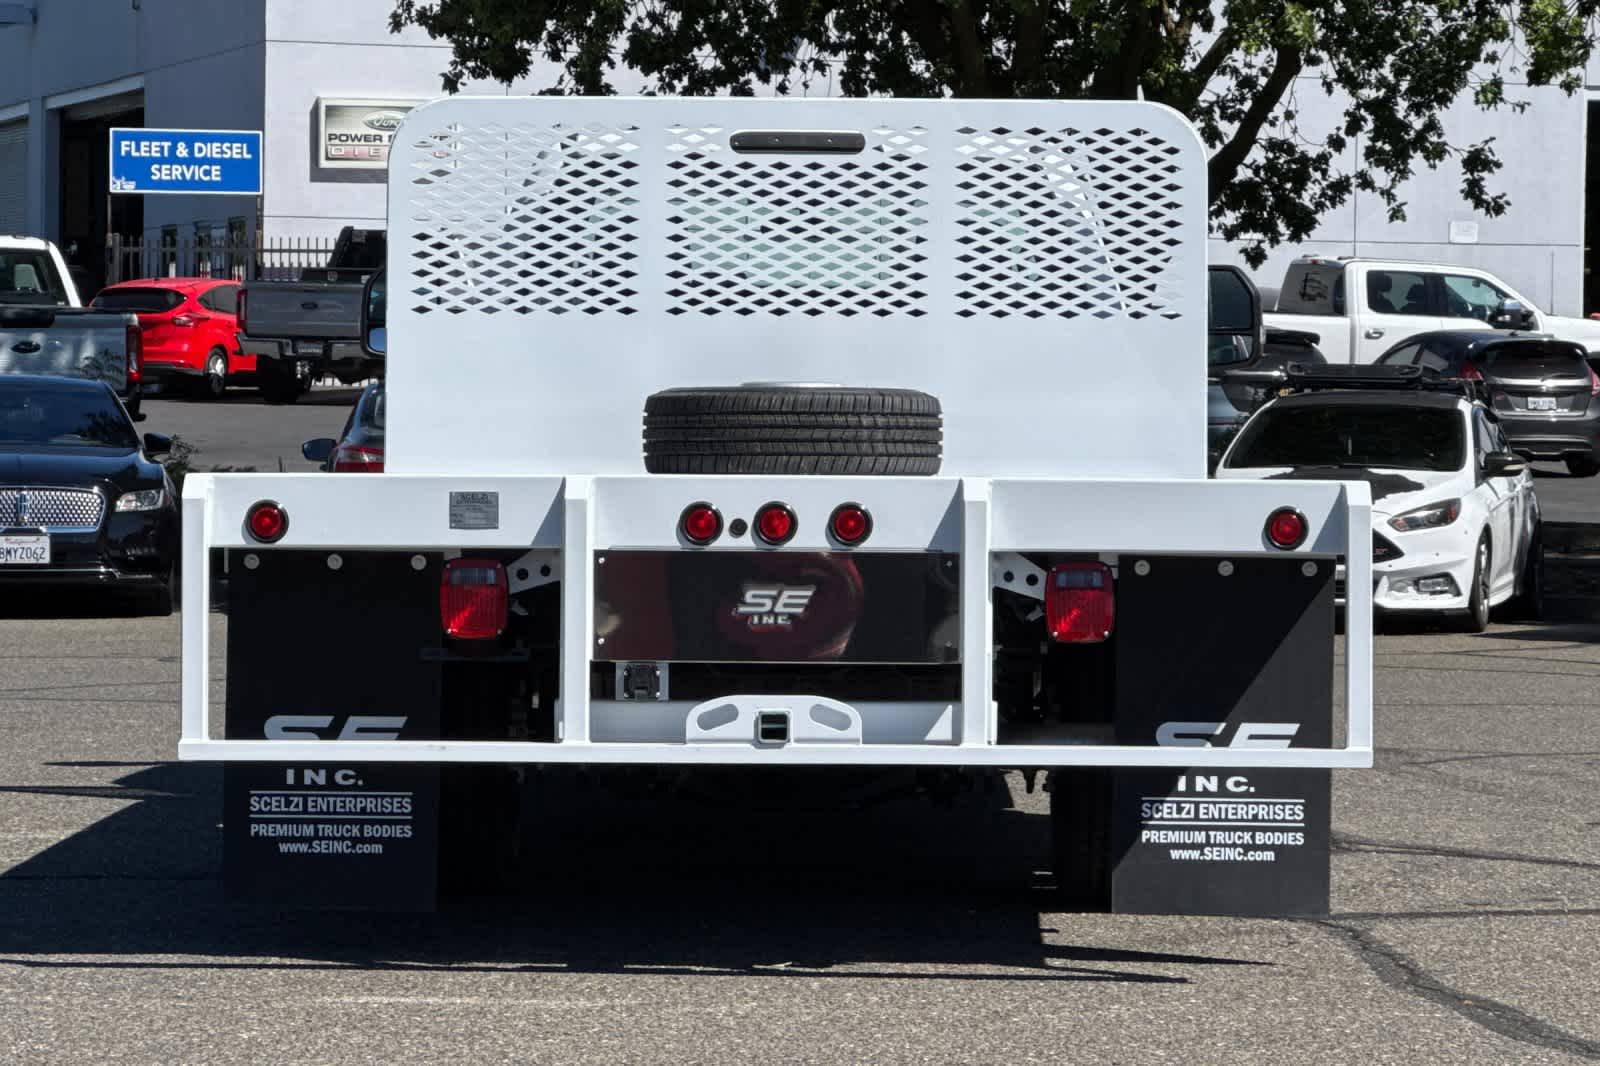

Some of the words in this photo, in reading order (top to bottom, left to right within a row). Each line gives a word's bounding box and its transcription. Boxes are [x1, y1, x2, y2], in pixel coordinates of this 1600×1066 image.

[327, 133, 383, 143] POWER
[120, 140, 172, 157] FLEET
[175, 141, 190, 158] &
[193, 142, 253, 159] DIESEL
[150, 164, 222, 181] SERVICE
[736, 589, 816, 613] SE
[286, 768, 364, 786] INC.
[1177, 775, 1256, 792] INC.
[249, 796, 303, 812] SCELZI
[307, 797, 412, 813] ENTERPRISES
[1141, 803, 1195, 819] SCELZI
[1199, 804, 1304, 820] ENTERPRISES
[250, 823, 314, 837] PREMIUM
[316, 824, 361, 838] TRUCK
[363, 825, 413, 839] BODIES
[1141, 830, 1206, 844] PREMIUM
[1207, 831, 1253, 844] TRUCK
[1255, 832, 1304, 845] BODIES
[278, 840, 383, 854] www.SEINC.com
[1170, 847, 1275, 861] www.SEINC.com
